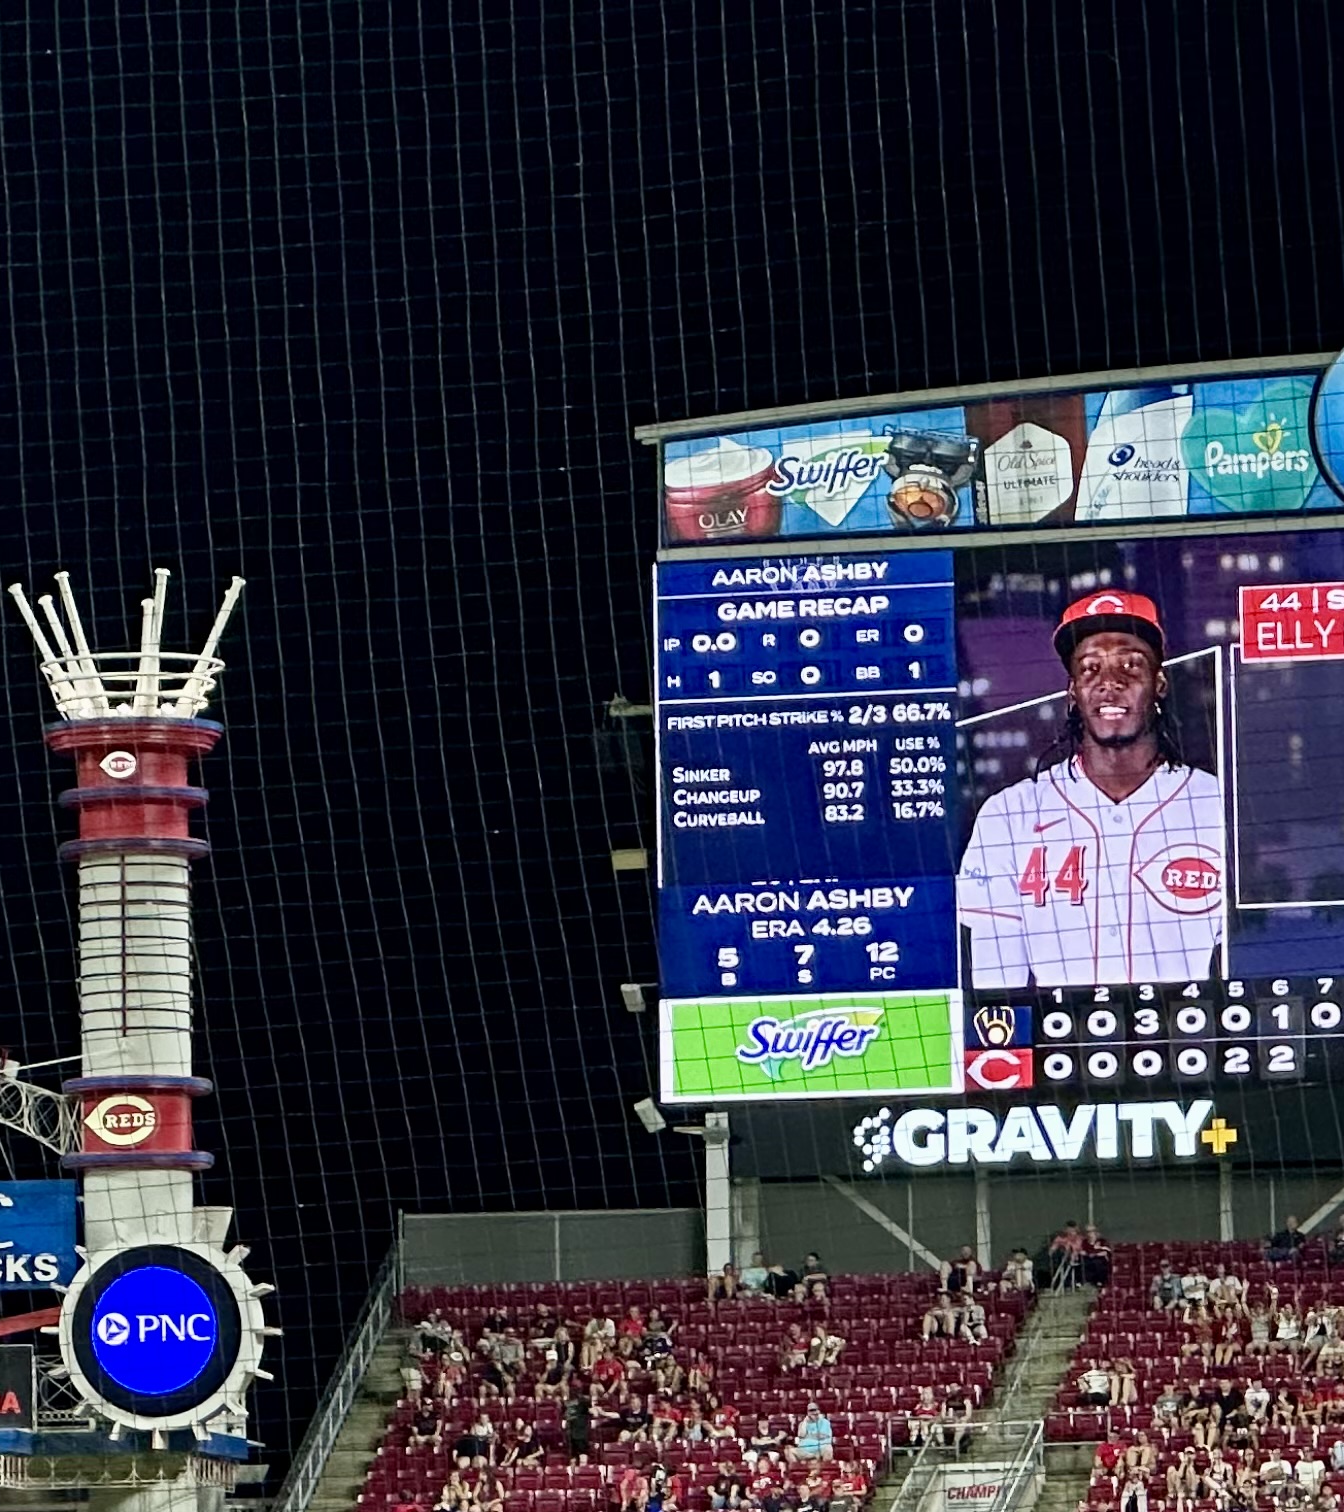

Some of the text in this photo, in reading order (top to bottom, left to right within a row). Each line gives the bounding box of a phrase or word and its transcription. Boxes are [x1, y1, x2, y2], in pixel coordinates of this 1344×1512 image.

[768, 449, 887, 496] Swiffer
[1206, 440, 1309, 479] Pampers
[698, 504, 749, 530] OLAY
[712, 561, 889, 587] AARON ASHBY
[717, 595, 890, 622] GAME RECAP
[1260, 591, 1301, 612] 44
[1256, 620, 1337, 651] ELLY
[667, 703, 951, 731] FIRST PITCH STRIKE % 2/3 66.7%
[808, 736, 940, 755] AVG MPH USE %
[823, 760, 864, 778] 97.8
[889, 756, 946, 775] 50.0%
[823, 782, 865, 799] 90.7
[891, 778, 945, 797] 33.3%
[824, 804, 865, 823] 83.2
[892, 801, 945, 820] 16.7%
[1019, 845, 1088, 906] 44
[692, 886, 915, 916] AARON ASHBY
[751, 916, 873, 940] ERA 4.26
[737, 1018, 877, 1067] Swiffer
[105, 1112, 156, 1129] REDS
[893, 1100, 1214, 1166] GRAVITY
[136, 1313, 211, 1343] PNC
